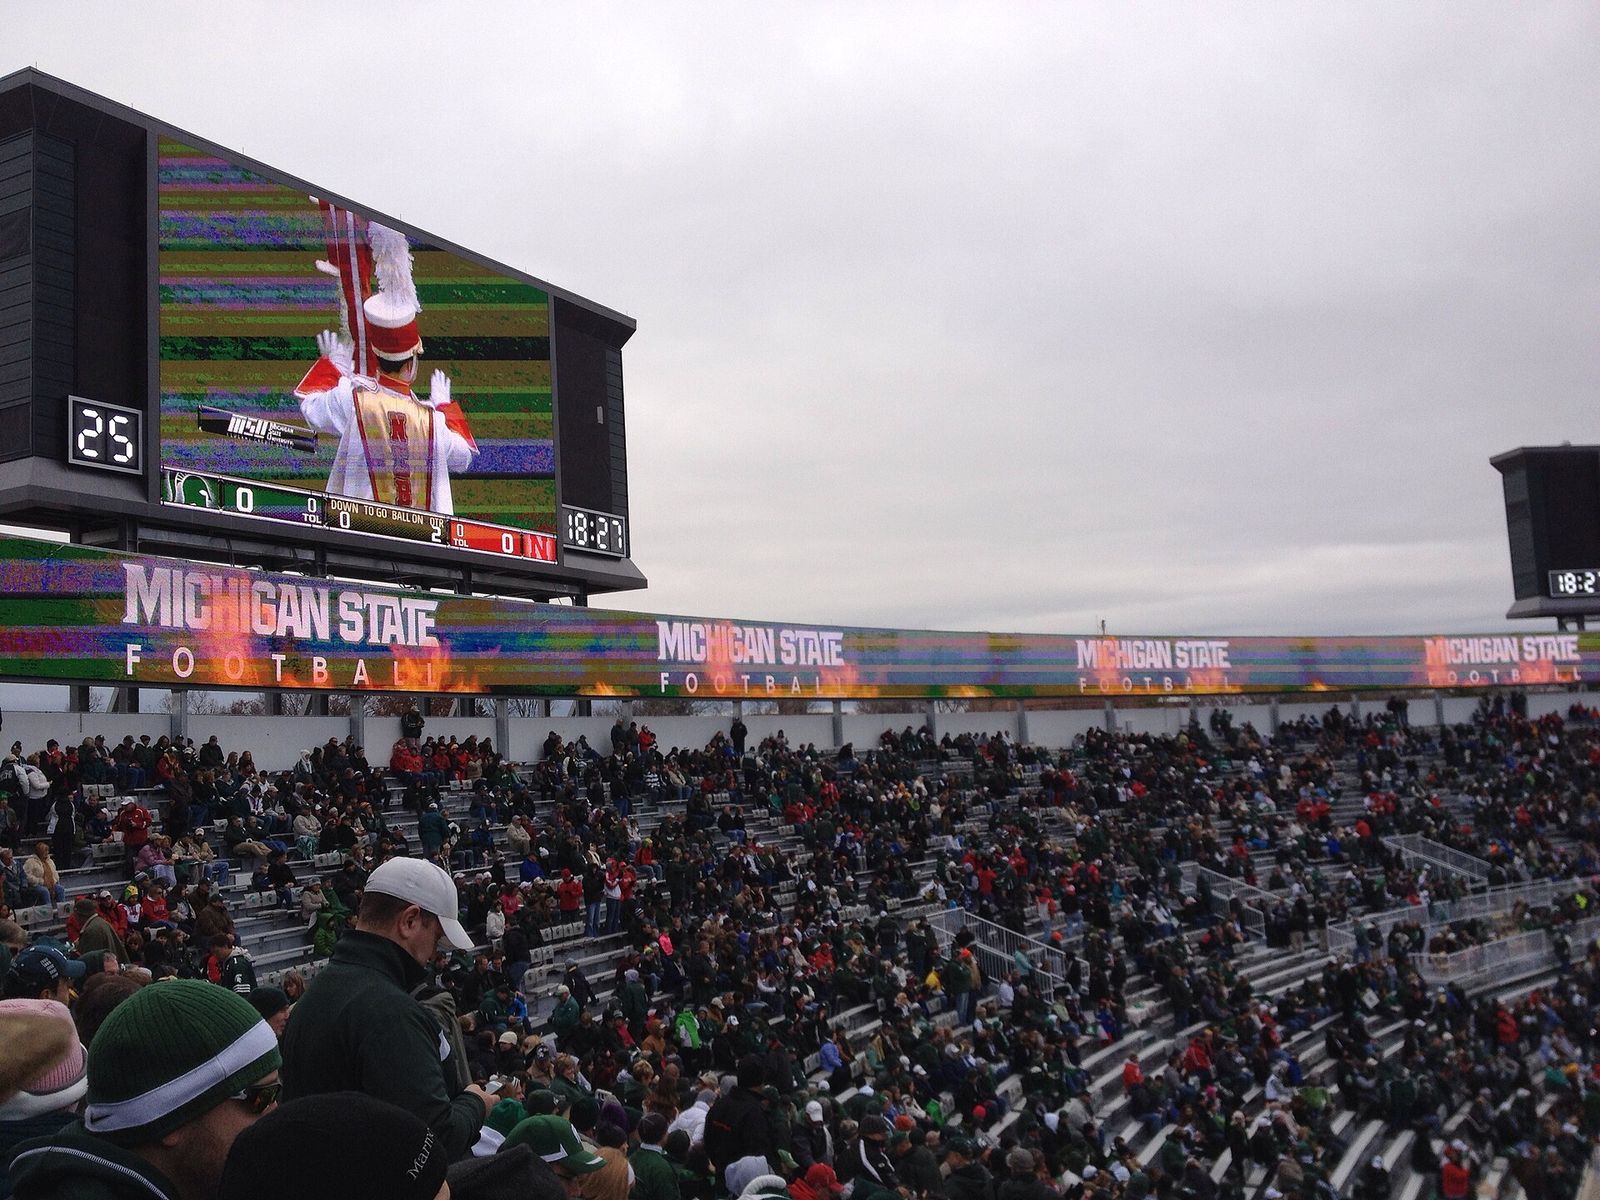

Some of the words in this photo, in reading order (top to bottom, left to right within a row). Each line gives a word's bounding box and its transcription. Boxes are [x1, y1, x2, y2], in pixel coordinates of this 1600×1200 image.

[78, 408, 133, 463] 25
[236, 487, 254, 513] 0
[307, 498, 317, 513] 0
[331, 500, 359, 514] DOWN
[364, 505, 375, 516] TO
[376, 508, 388, 519] GO
[302, 512, 322, 525] TOL
[340, 511, 350, 529] 0
[392, 510, 411, 523] BALL
[412, 514, 424, 525] ON
[430, 517, 444, 528] QTR
[431, 526, 442, 543] 2
[456, 523, 464, 538] 0
[568, 512, 623, 550] 18:27
[453, 537, 469, 548] TOL
[501, 533, 514, 554] 0
[528, 534, 555, 561] N
[1558, 571, 1600, 594] 18:2
[122, 563, 331, 641] MICHIGAN
[339, 591, 439, 648] STATE
[656, 621, 776, 665] MICHIGAN
[780, 629, 845, 666] STATE
[1075, 639, 1172, 669] MICHIGAN
[1175, 640, 1232, 668] STATE
[1424, 635, 1520, 665] MICHIGAN
[1523, 635, 1582, 662] STATE
[126, 643, 437, 687] FOOTBALL
